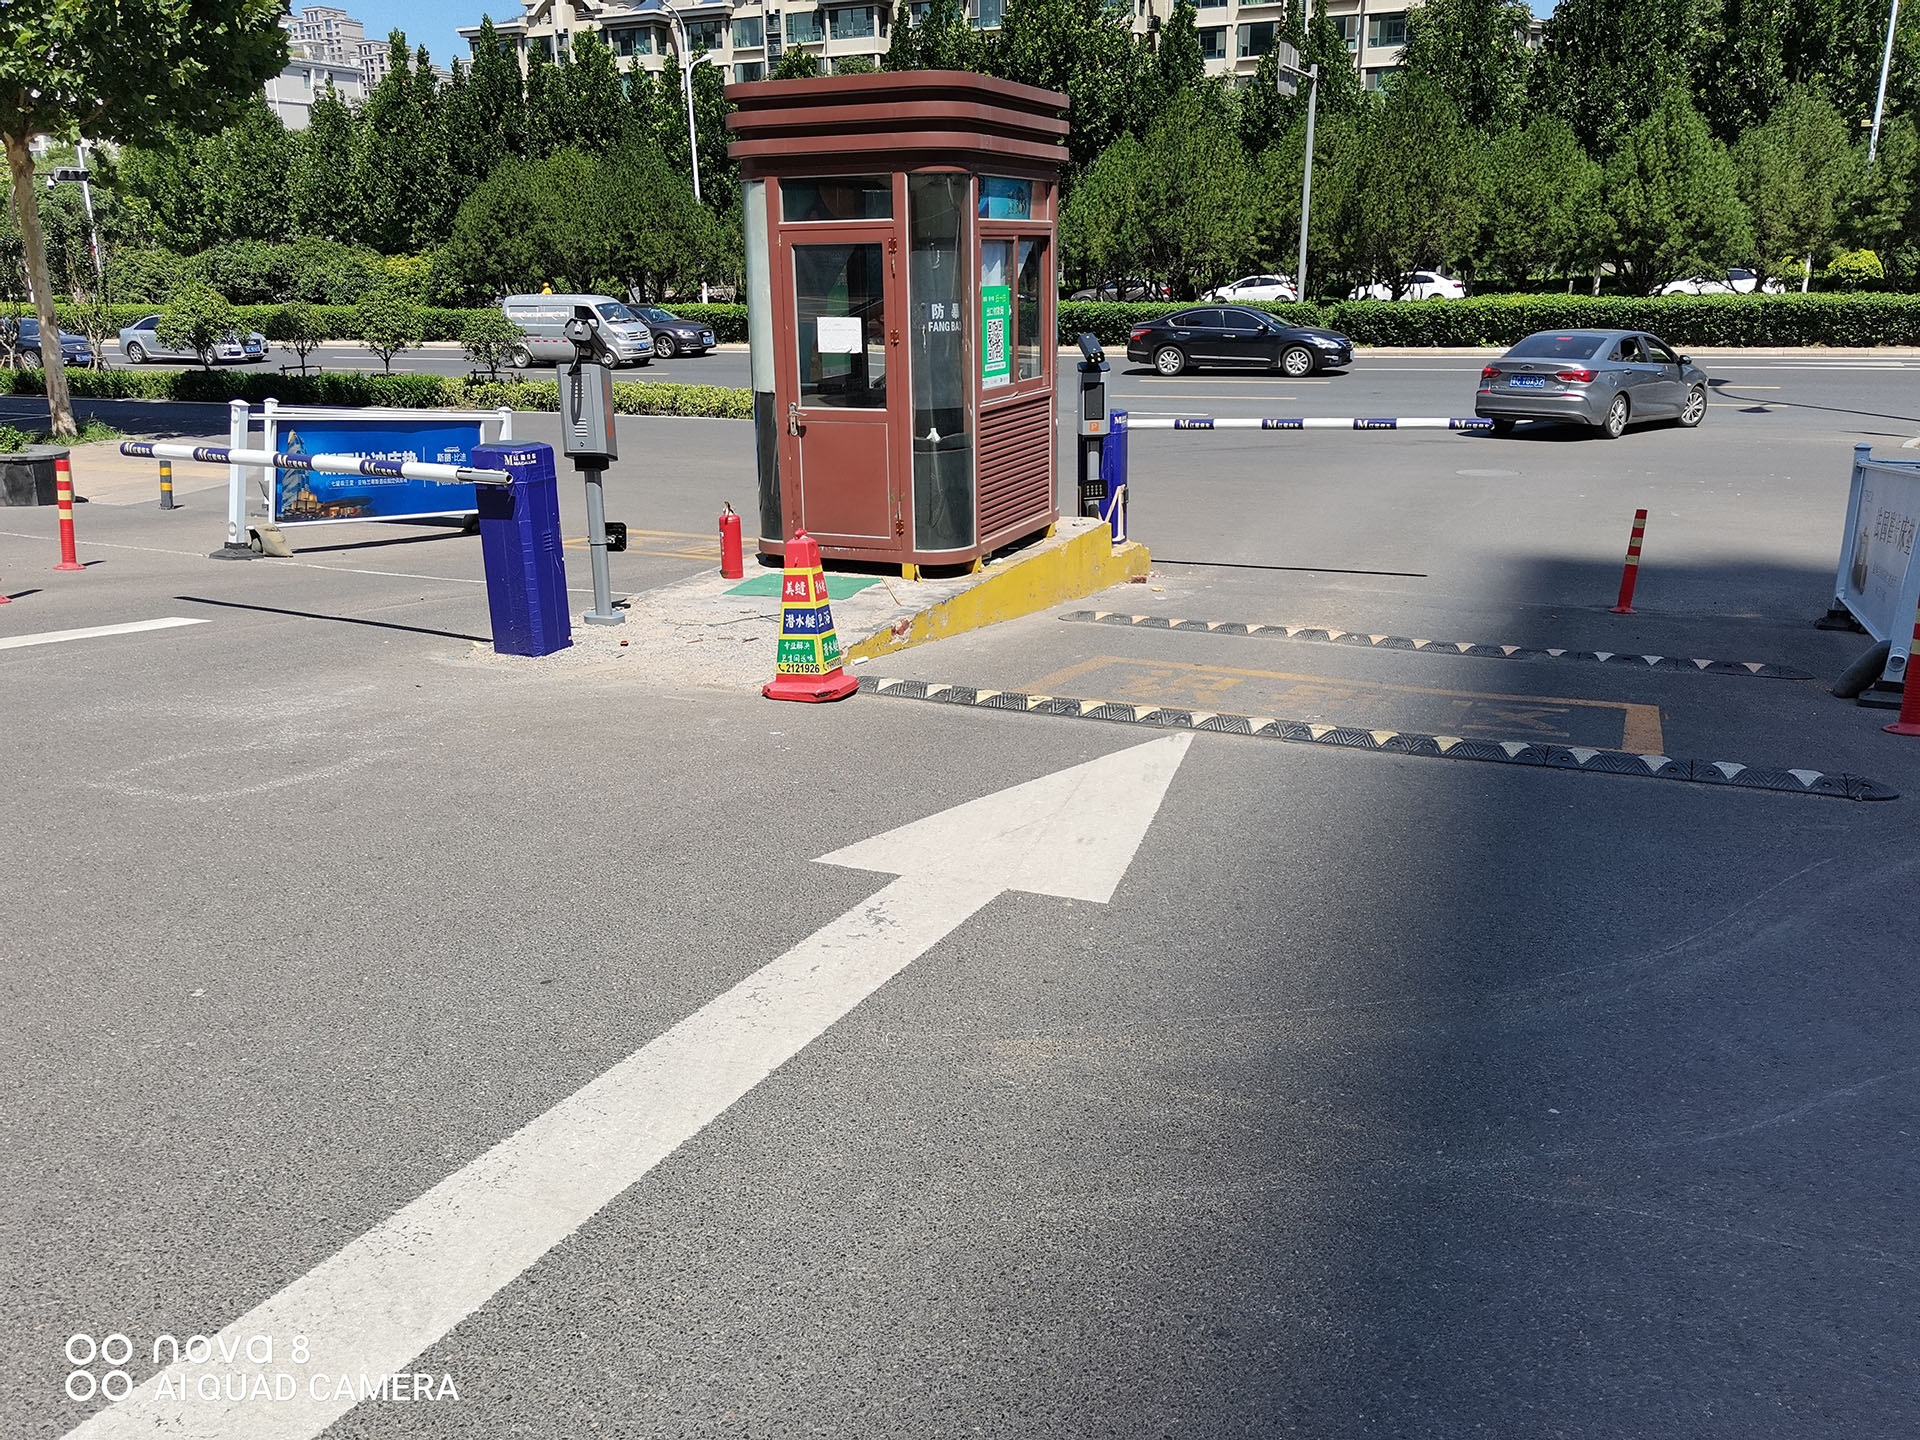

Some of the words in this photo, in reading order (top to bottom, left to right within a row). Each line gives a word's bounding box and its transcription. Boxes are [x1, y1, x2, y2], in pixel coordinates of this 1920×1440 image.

[928, 321, 950, 332] FANG
[785, 581, 806, 596] 美缝
[785, 613, 816, 629] 潜水艇
[784, 641, 811, 651] 专业解决
[786, 664, 820, 674] 2121926
